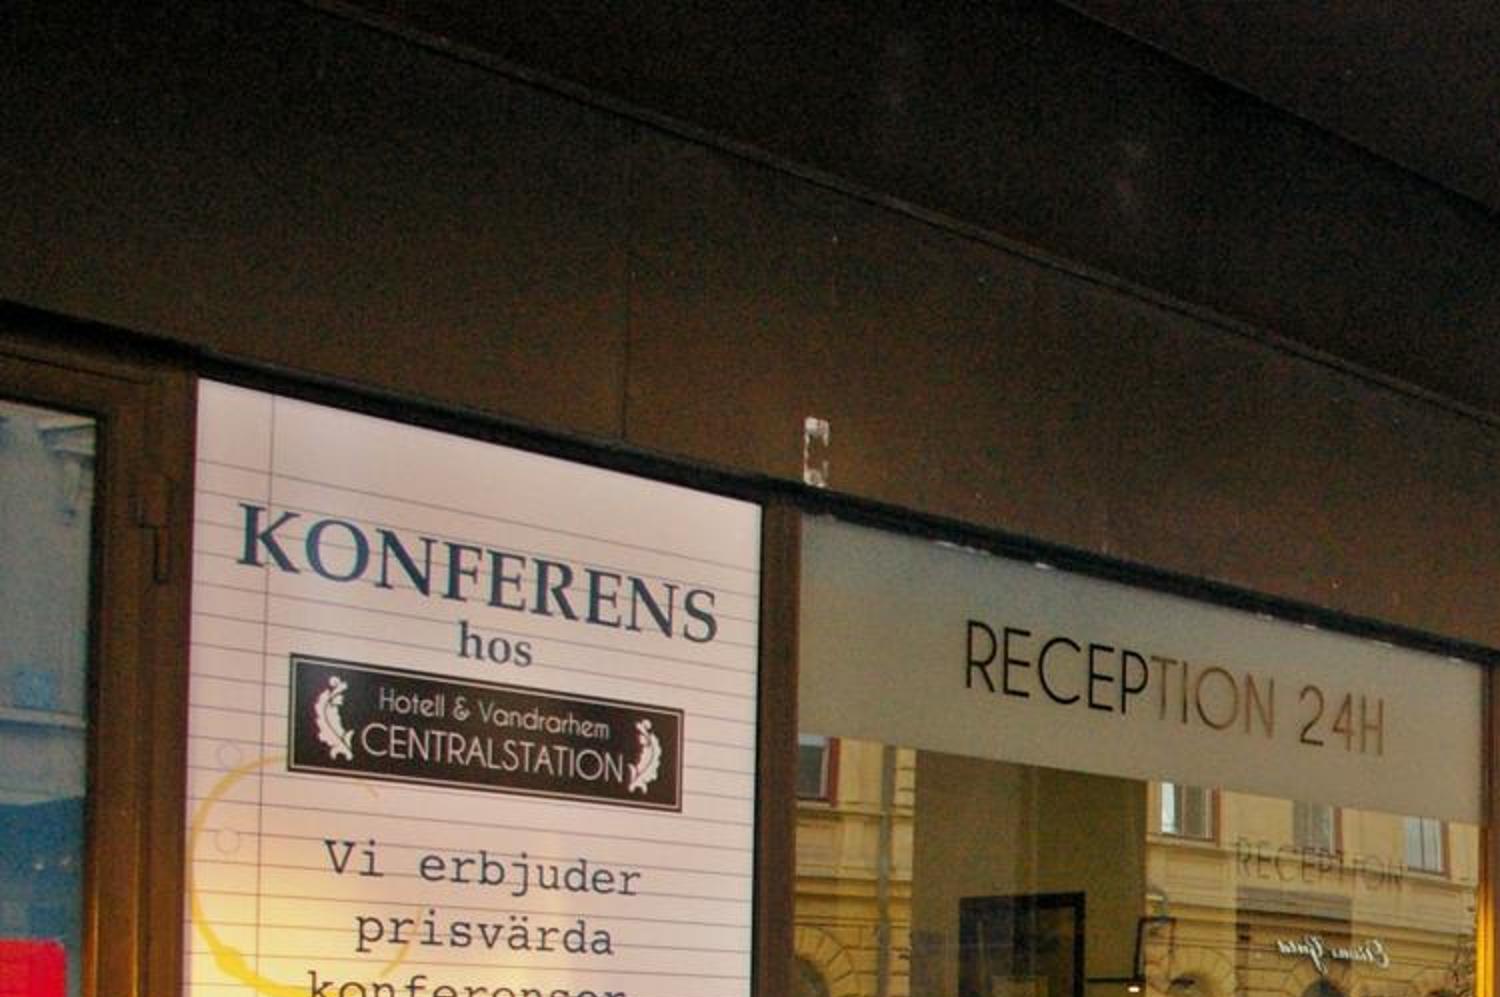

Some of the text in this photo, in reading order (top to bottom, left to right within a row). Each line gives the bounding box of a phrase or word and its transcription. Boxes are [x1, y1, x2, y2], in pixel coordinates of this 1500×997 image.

[236, 502, 718, 643] KONFERENS
[458, 620, 533, 667] hos
[379, 687, 610, 741] Hotell & Vandrarhem
[965, 619, 1385, 757] RECEPTION 24H
[361, 723, 624, 785] CENTRALSTATION
[323, 838, 643, 897] Vi erbjuder
[355, 912, 614, 957] prisvärda
